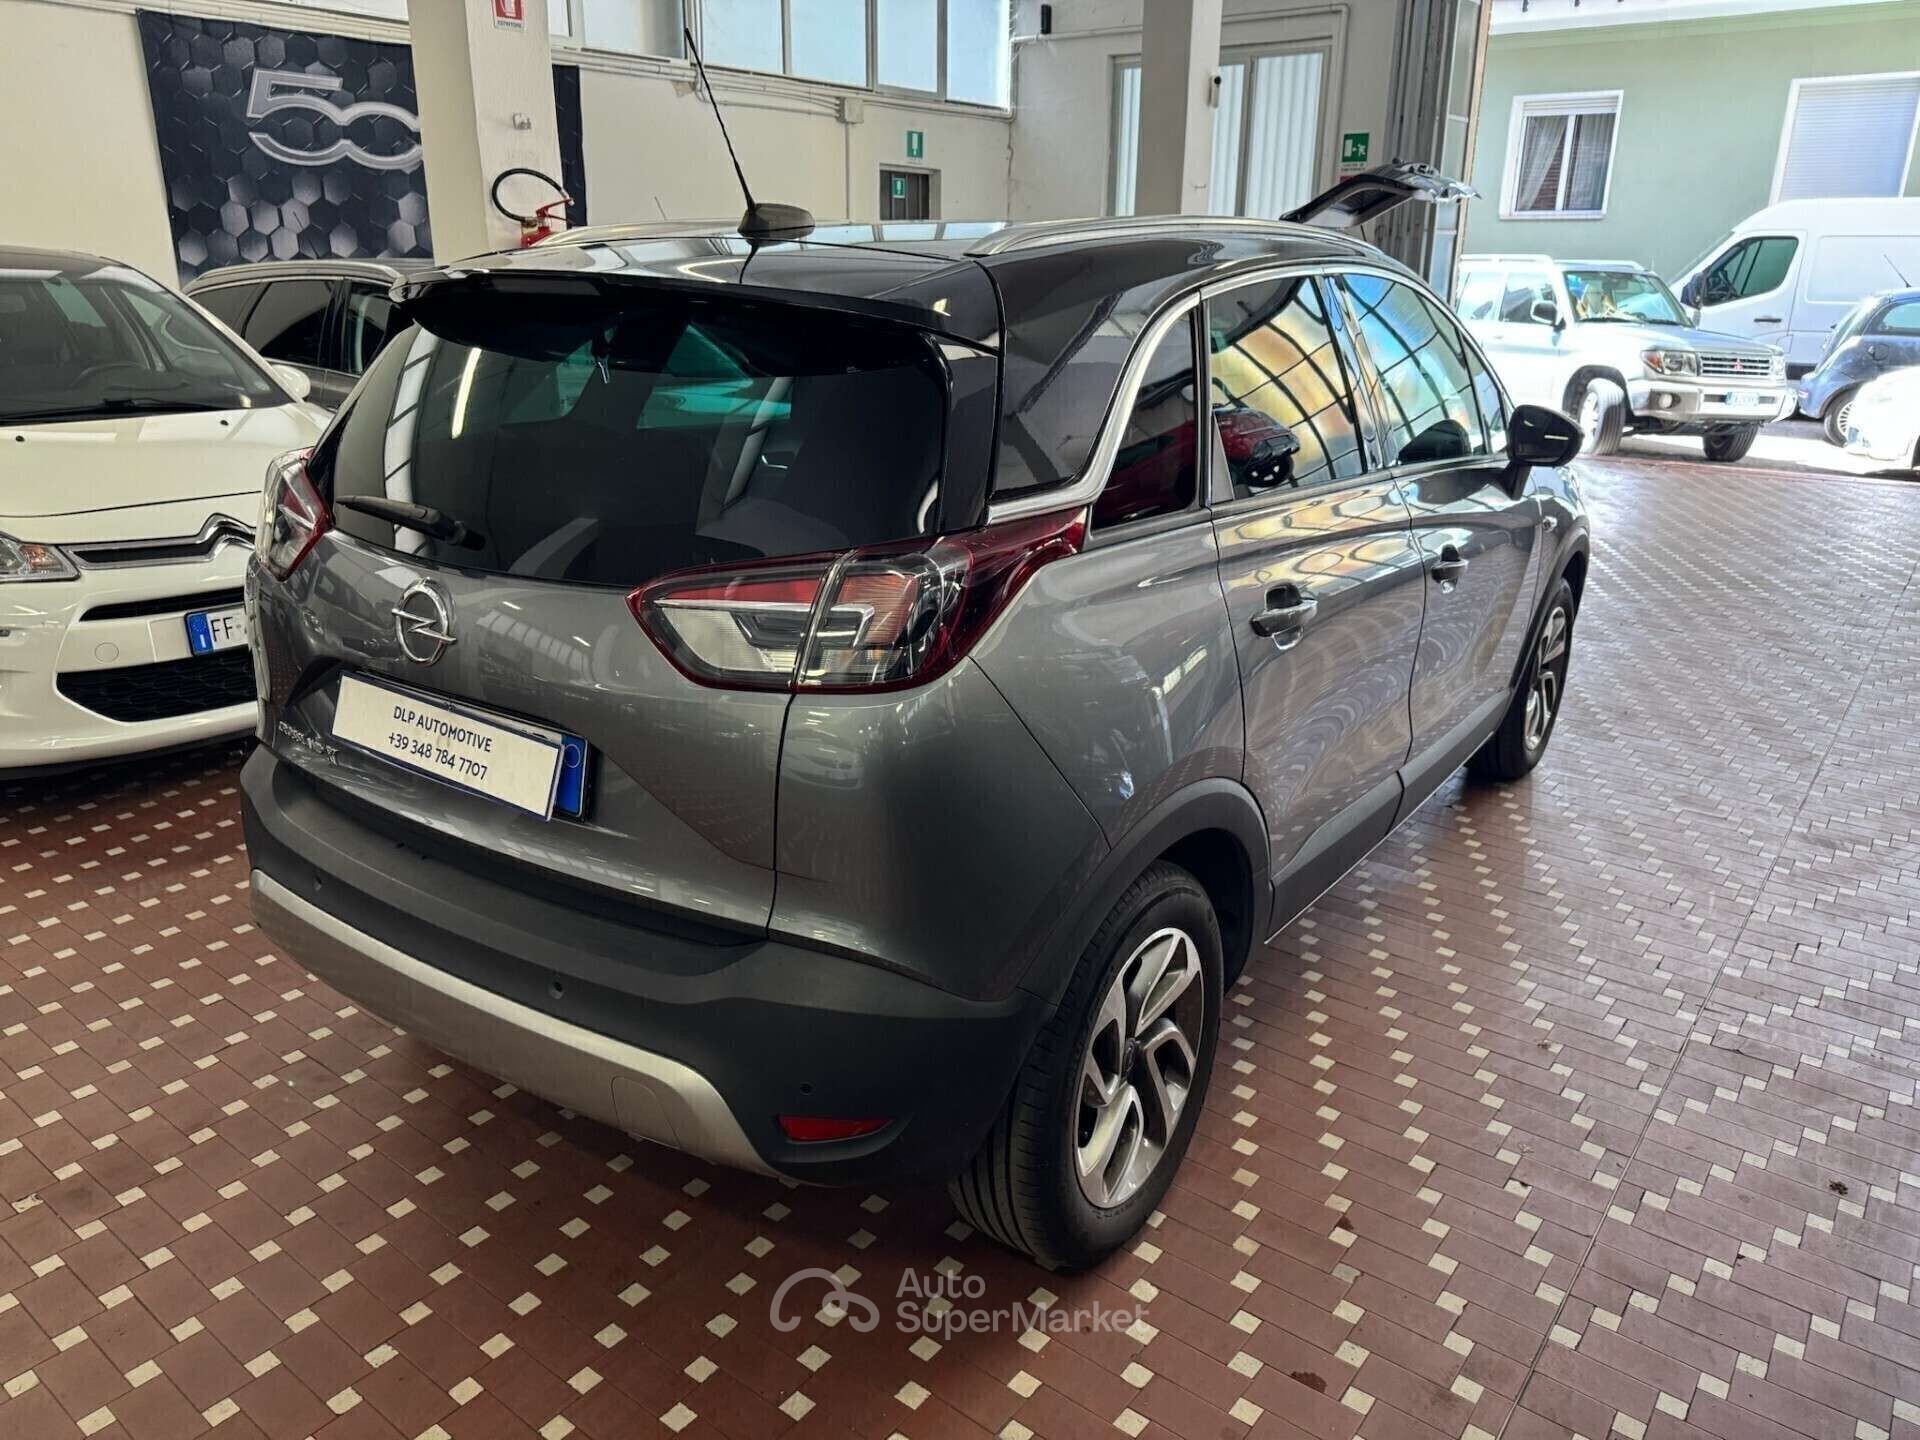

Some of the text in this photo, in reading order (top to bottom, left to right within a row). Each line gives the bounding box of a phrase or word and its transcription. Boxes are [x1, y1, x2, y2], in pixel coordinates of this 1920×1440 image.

[246, 68, 421, 170] 50
[393, 706, 492, 752] DLP AUTOMOTIVE
[389, 732, 488, 780] +39 348 784 7707
